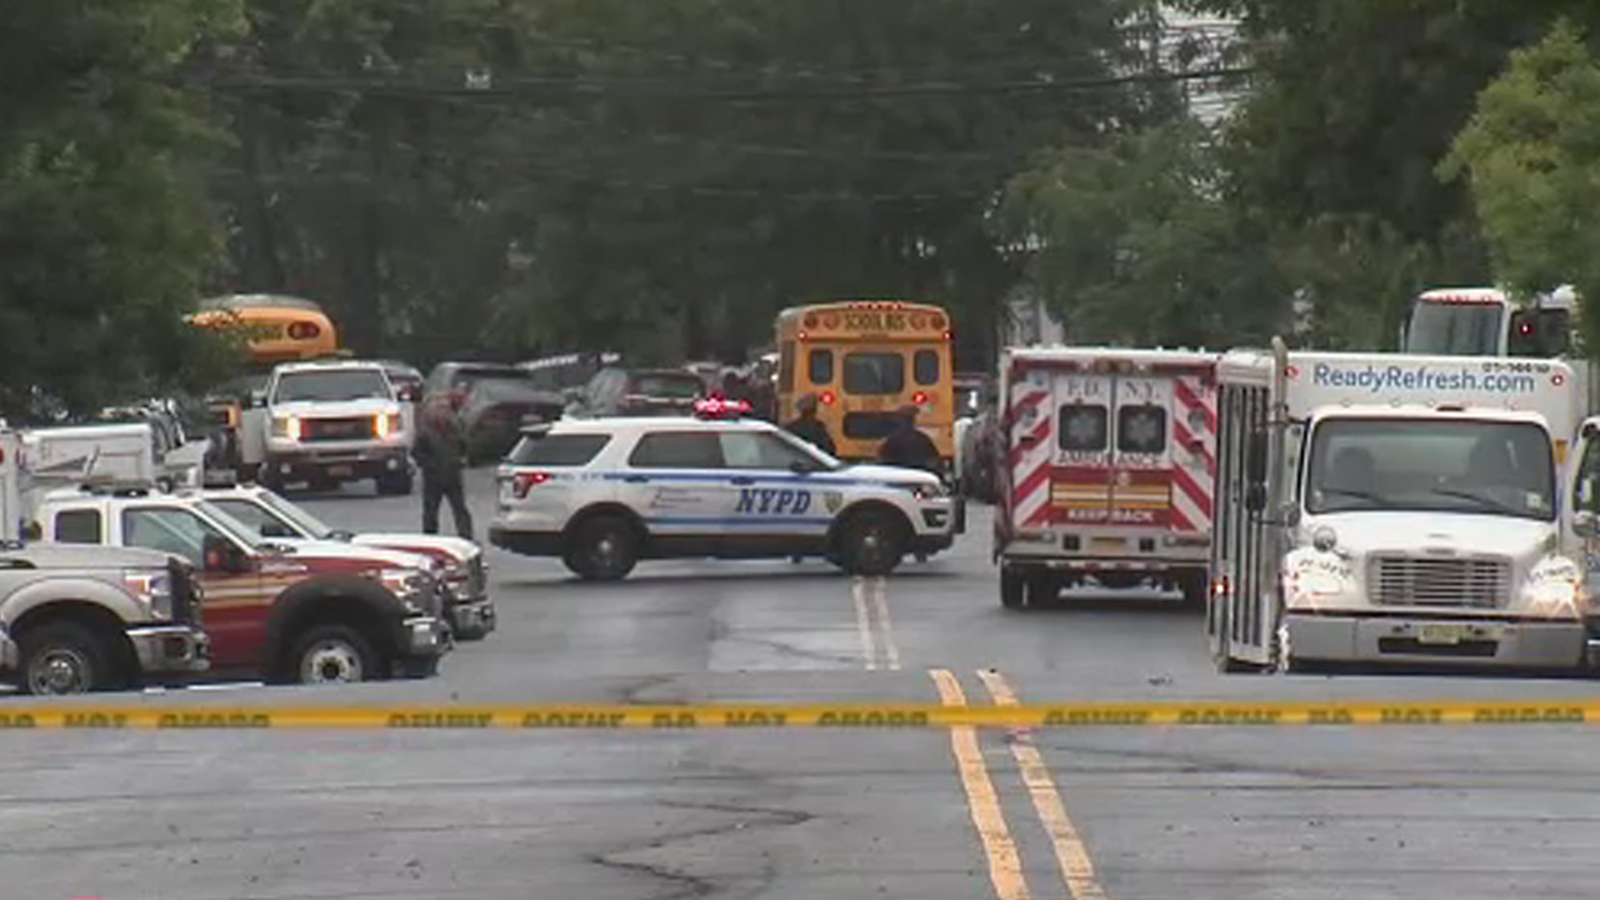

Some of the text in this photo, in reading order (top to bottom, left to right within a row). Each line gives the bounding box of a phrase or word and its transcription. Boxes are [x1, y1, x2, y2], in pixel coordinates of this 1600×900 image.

[1313, 363, 1535, 393] ReadyRefresh.com
[735, 488, 813, 515] NYPD
[1067, 508, 1154, 522] KEEP BACK
